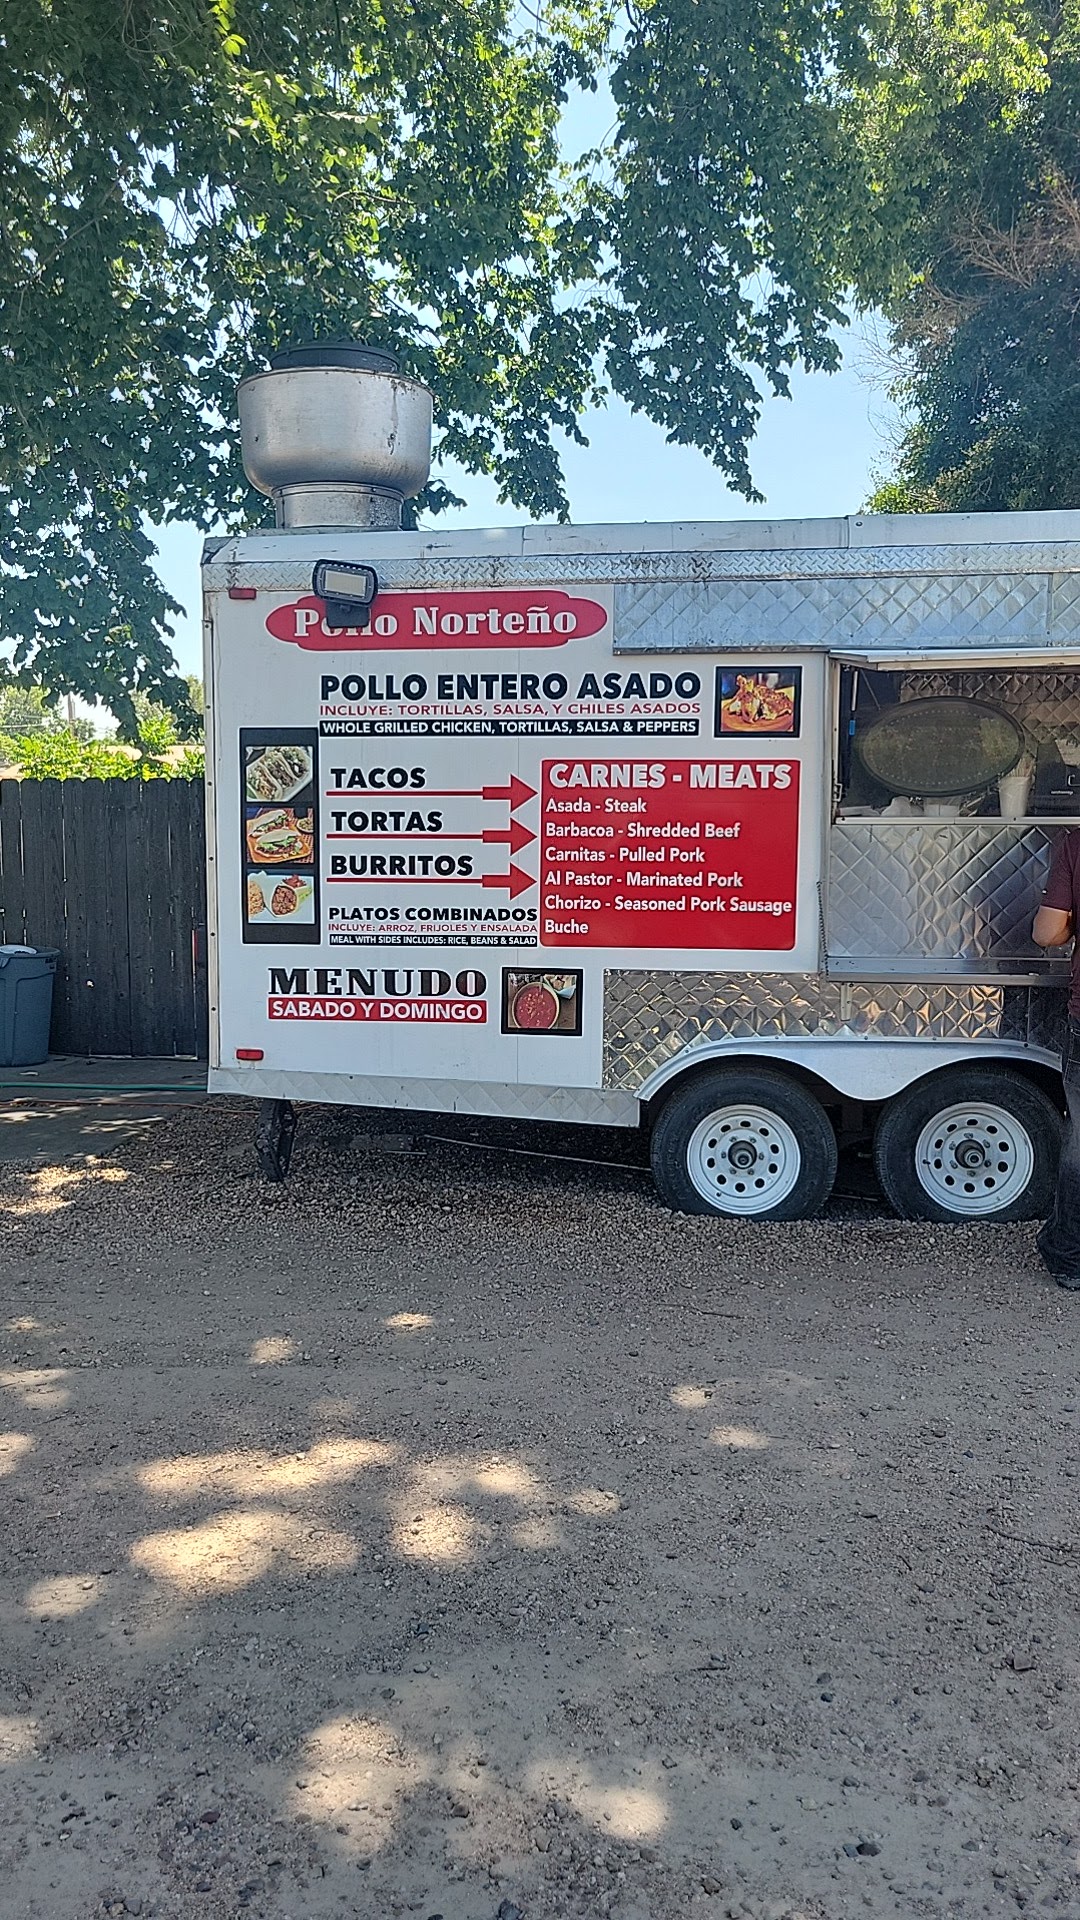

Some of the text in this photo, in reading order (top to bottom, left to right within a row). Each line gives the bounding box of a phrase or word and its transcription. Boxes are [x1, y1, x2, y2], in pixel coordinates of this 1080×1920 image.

[413, 606, 577, 635] Norteño
[321, 672, 701, 701] POLLO ENTERO ASADO
[320, 703, 701, 716] INCLUYE: TORTILLAS, SALSA, Y CHILES ASADOS
[322, 721, 697, 735] WHOLE GRILLED CHICKEN, TORTILLAS, SALSA & PEPPERS
[330, 767, 426, 789] TACOS
[549, 763, 666, 789] CARNES
[689, 764, 792, 790] MEATS
[545, 798, 592, 813] Asada
[604, 797, 647, 813] Steak
[331, 811, 443, 832] TORTAS
[545, 822, 614, 838] Barbacoa
[627, 822, 701, 838] Shredded
[704, 822, 741, 838] Beef
[545, 846, 606, 862] Carnitas
[619, 847, 665, 862] Pulled
[669, 847, 706, 863] Pork
[331, 855, 473, 876] BURRITOS
[545, 870, 561, 886] Al
[565, 871, 613, 886] Pastor
[626, 872, 703, 887] Marinated
[707, 872, 744, 888] Pork
[329, 907, 538, 922] PLATOS COMBINADOS
[545, 895, 601, 910] Chorizo
[614, 895, 686, 911] Seasoned
[690, 896, 726, 912] Pork
[729, 897, 793, 916] Sausage
[328, 923, 538, 933] INCLUYE: ARROZ, FRIJOLES Y ENSALADA
[545, 919, 589, 934] Buche
[331, 935, 537, 946] MEAL WITH SIDES INCLUDES: RICE, BEANS & SALAD
[267, 967, 487, 997] MENUDO
[272, 1000, 483, 1020] SABADO Y DOMINGO
